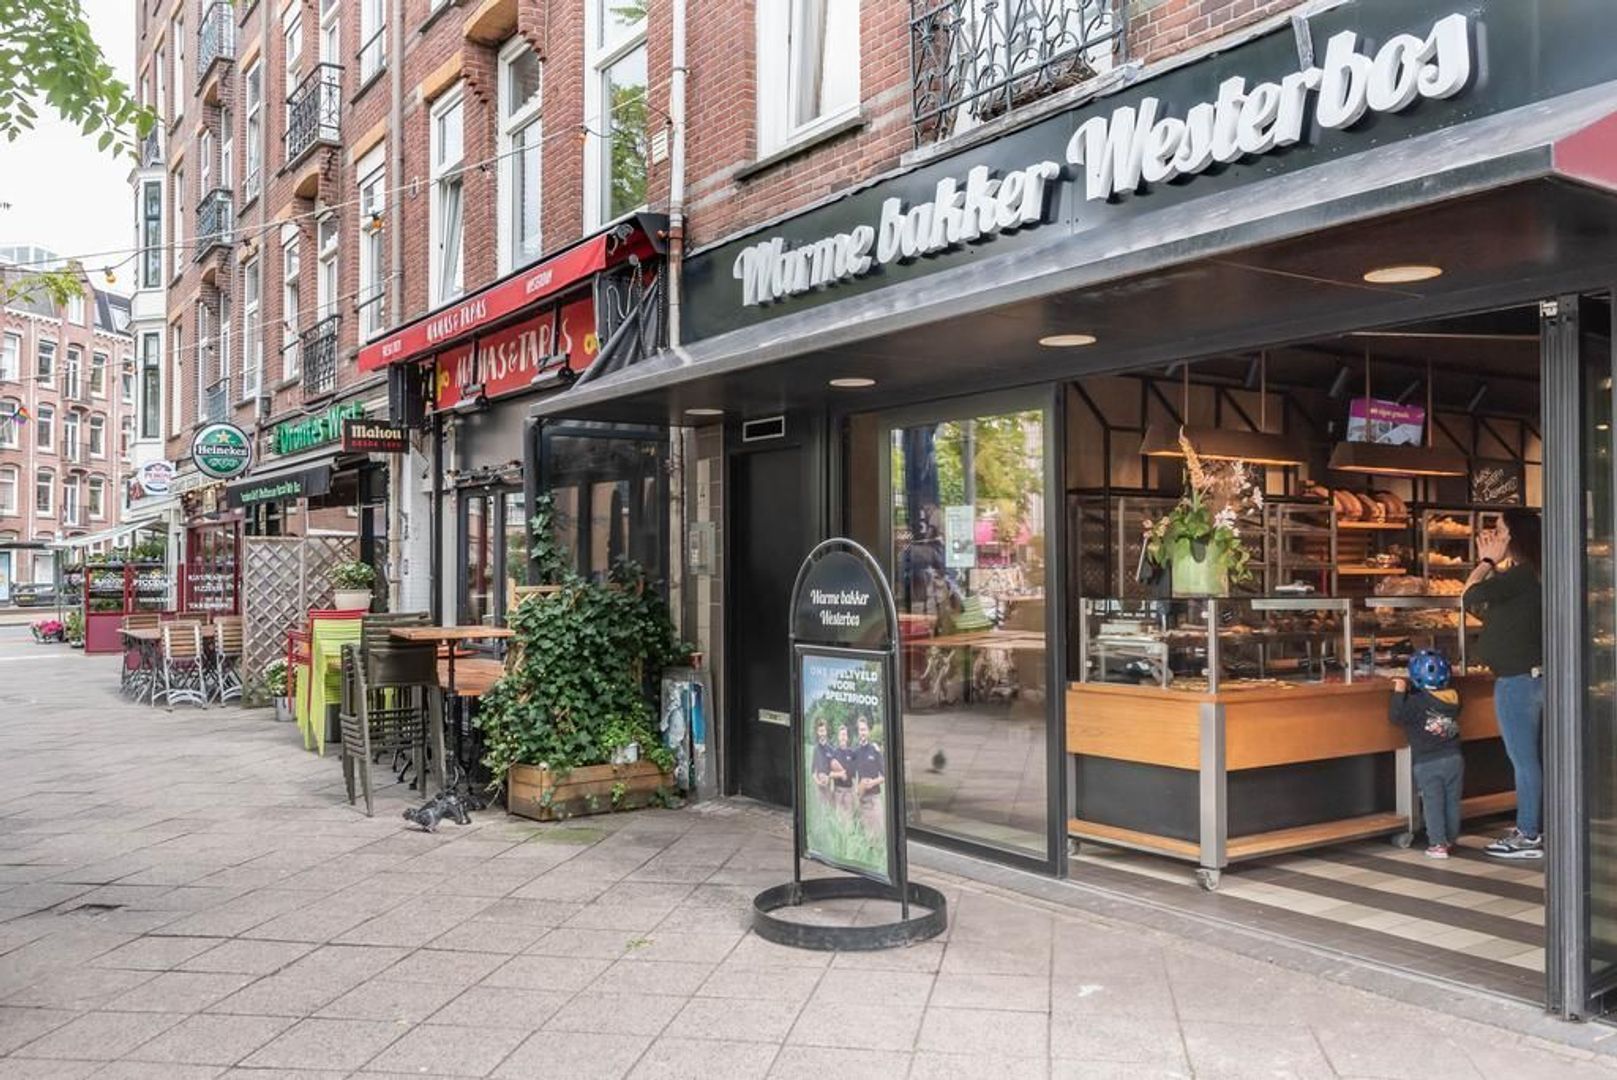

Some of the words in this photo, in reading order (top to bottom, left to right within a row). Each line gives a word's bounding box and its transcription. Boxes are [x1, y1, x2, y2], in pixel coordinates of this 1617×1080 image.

[1067, 12, 1471, 201] Westerbos
[733, 224, 876, 306] Warme
[877, 160, 1059, 264] bakker
[352, 424, 402, 439] Mahou
[198, 444, 247, 456] Heineken
[810, 589, 839, 605] Warme
[840, 590, 869, 606] bakker
[819, 609, 860, 626] Westerbos
[830, 681, 856, 692] VOOR
